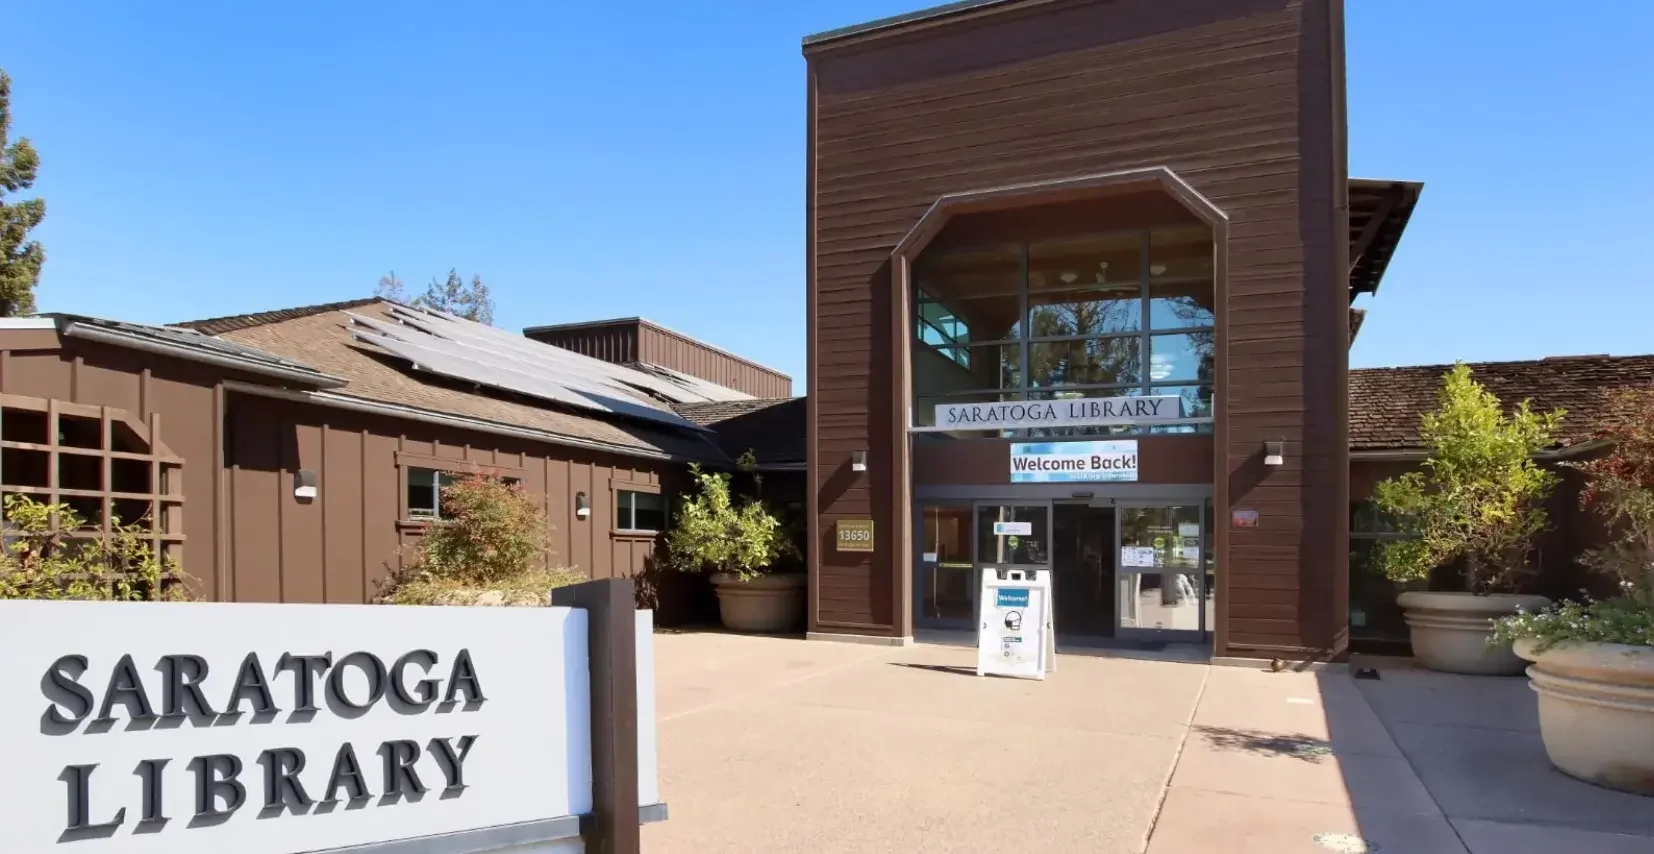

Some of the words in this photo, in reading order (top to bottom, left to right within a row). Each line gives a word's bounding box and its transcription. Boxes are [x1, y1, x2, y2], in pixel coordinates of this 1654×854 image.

[948, 403, 1057, 423] SARATOGA
[1070, 399, 1163, 418] LIBRARY
[1013, 457, 1085, 471] Welcome
[1091, 455, 1136, 470] Back!
[839, 530, 870, 541] 13650
[40, 648, 487, 735] SARATOGA
[56, 734, 480, 843] LIBRARY
